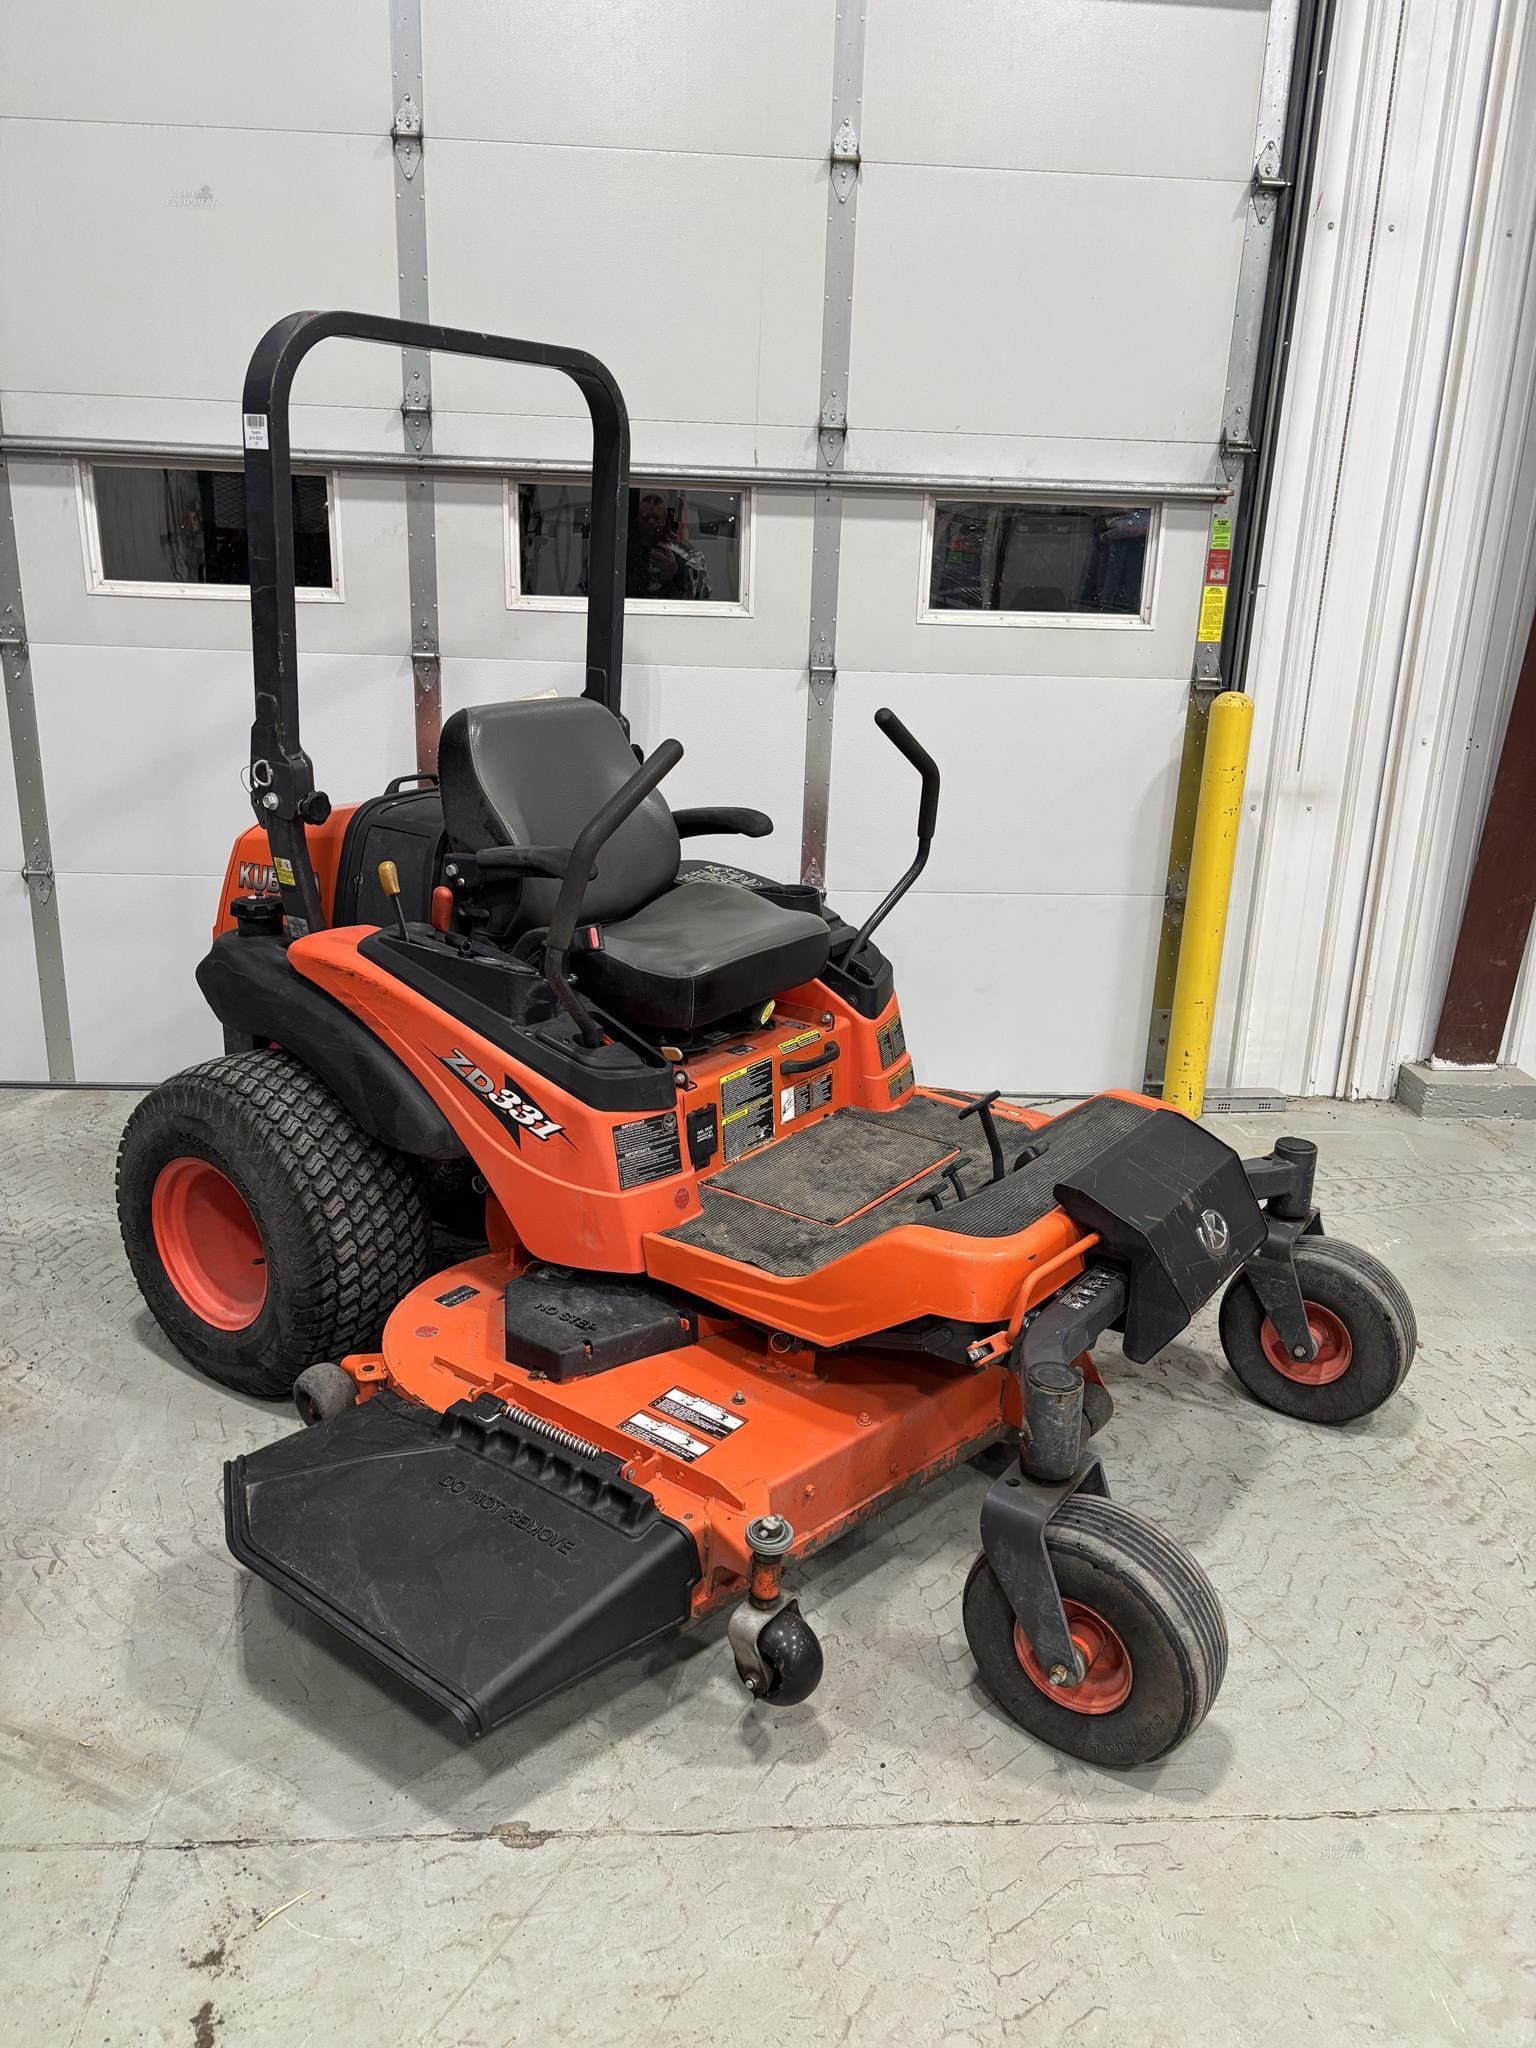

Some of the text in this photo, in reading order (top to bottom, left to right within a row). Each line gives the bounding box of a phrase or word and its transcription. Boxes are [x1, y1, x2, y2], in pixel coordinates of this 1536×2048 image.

[440, 1047, 566, 1142] ZD331
[535, 1303, 598, 1332] NO STEP
[438, 1474, 576, 1556] DO NOT REMOVE
